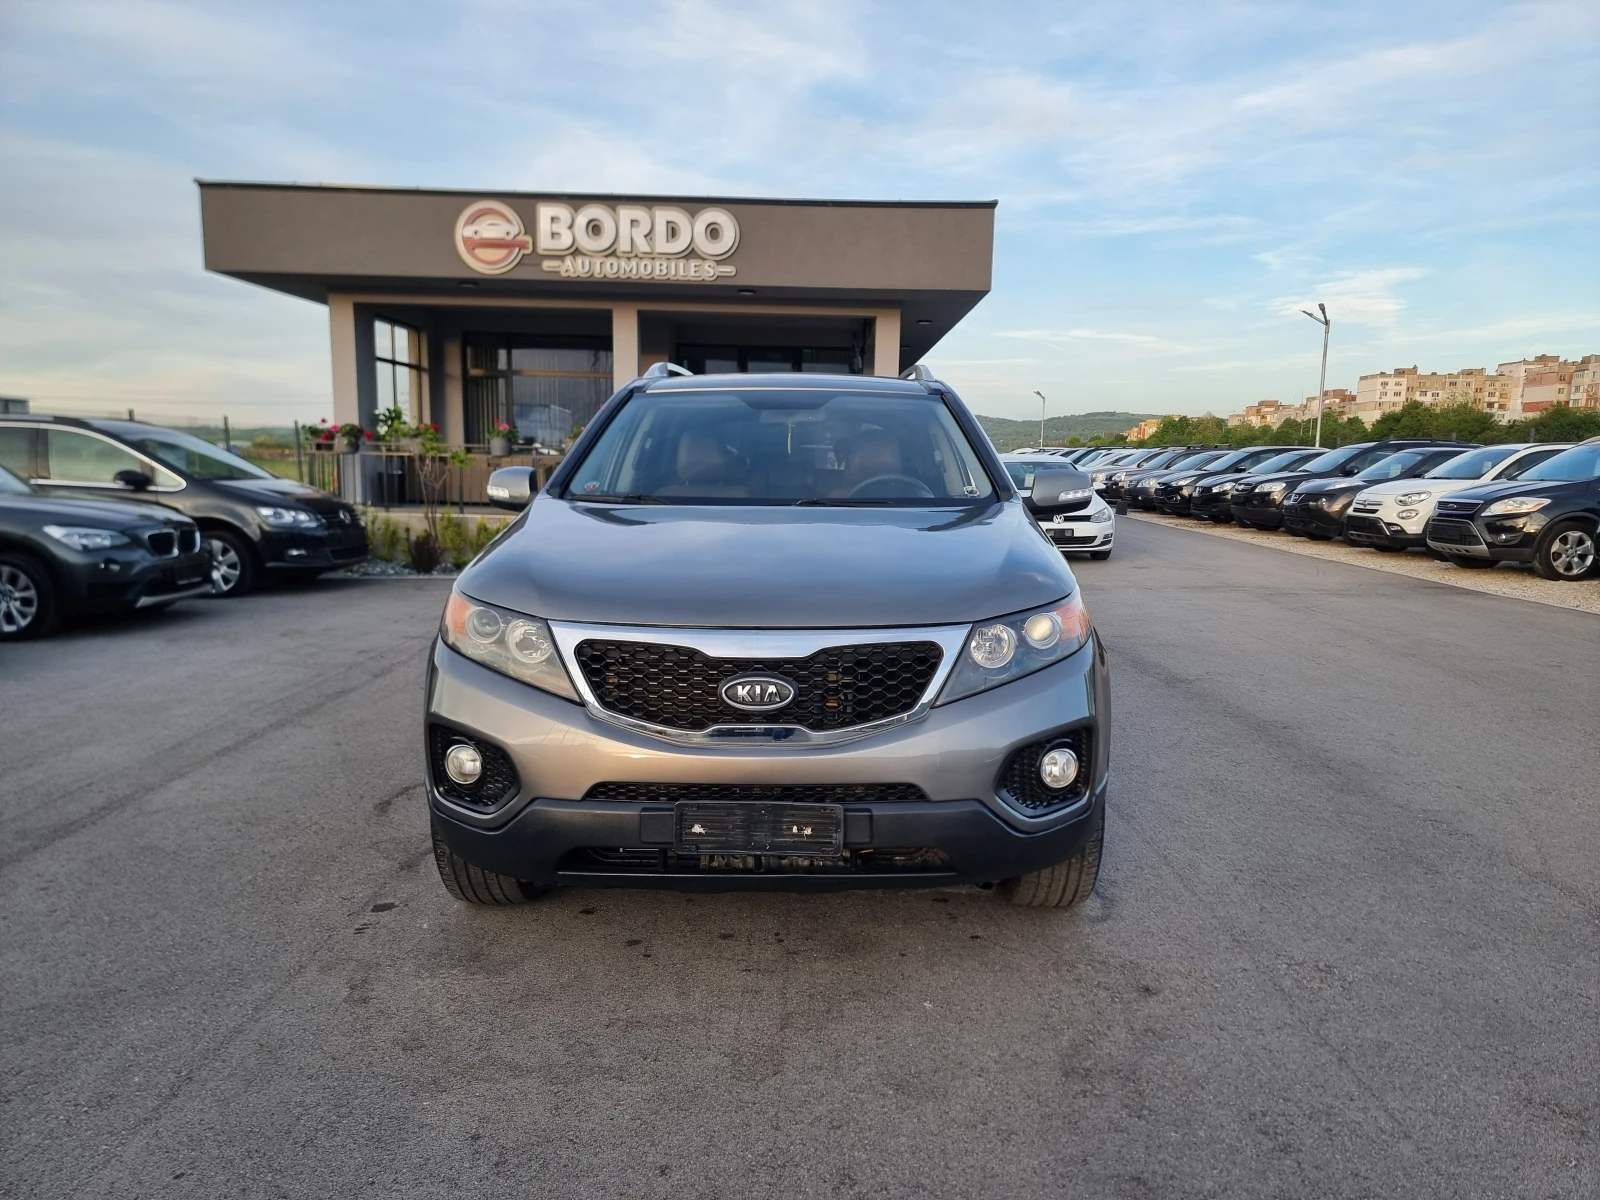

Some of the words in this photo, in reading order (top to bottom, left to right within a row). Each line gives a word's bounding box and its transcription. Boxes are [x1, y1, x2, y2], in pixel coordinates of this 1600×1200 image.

[538, 204, 738, 258] BORDO
[562, 257, 717, 279] AUTOMOBILES
[736, 684, 781, 702] KIA
